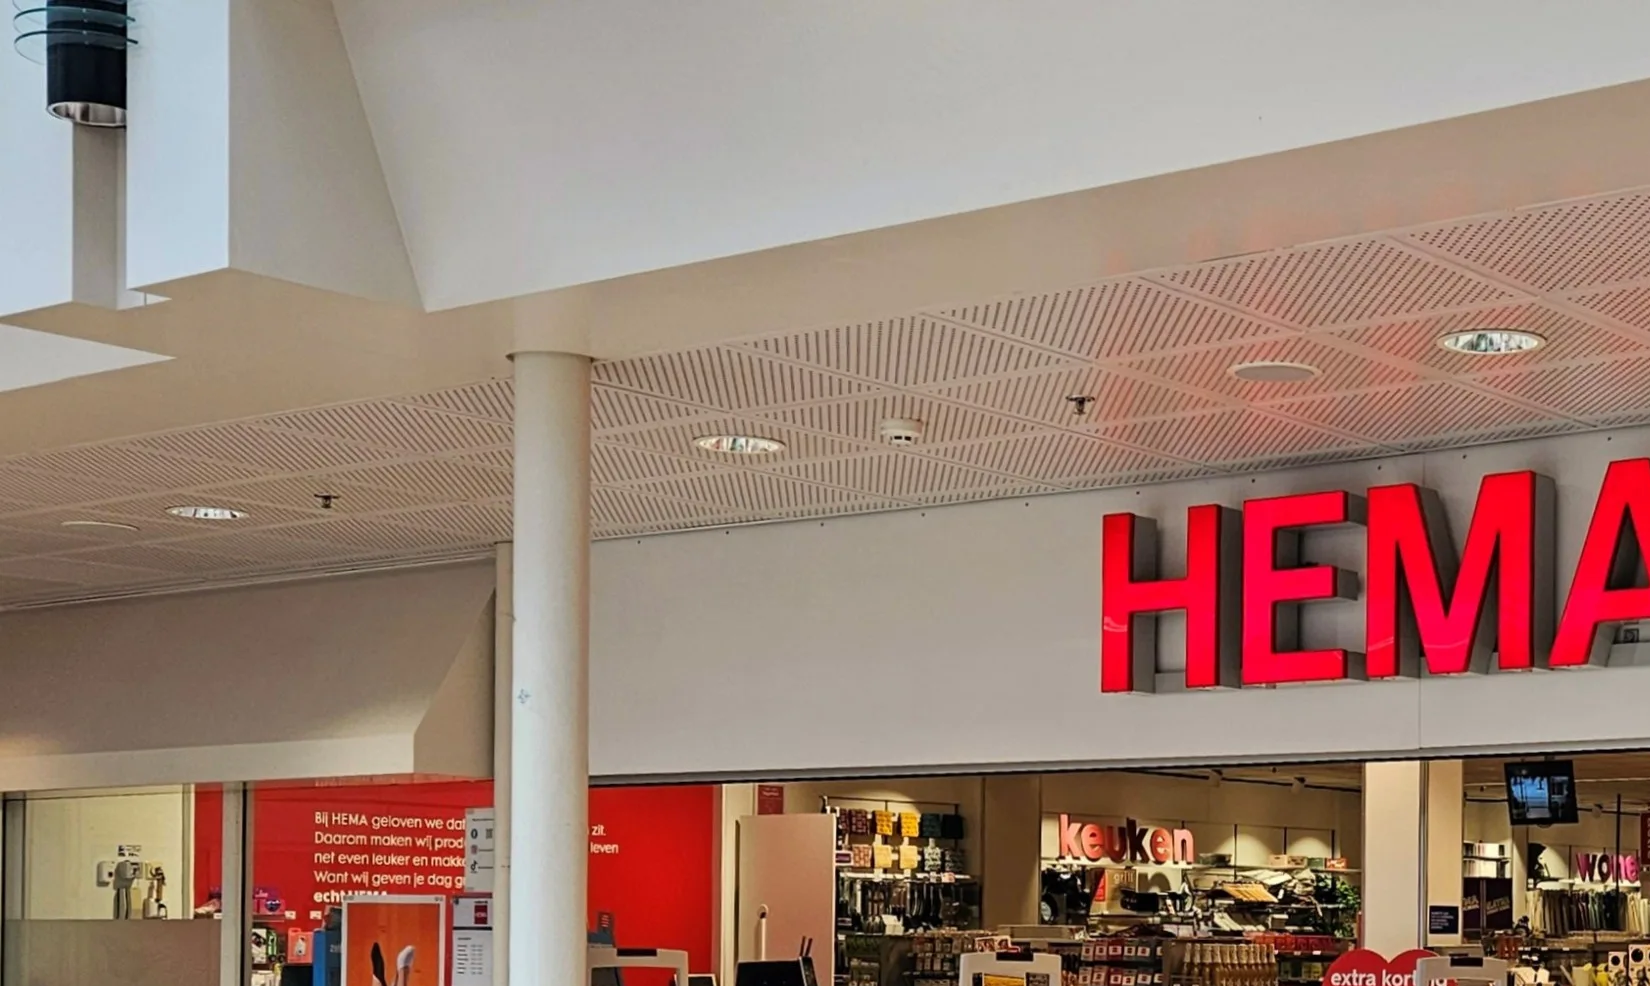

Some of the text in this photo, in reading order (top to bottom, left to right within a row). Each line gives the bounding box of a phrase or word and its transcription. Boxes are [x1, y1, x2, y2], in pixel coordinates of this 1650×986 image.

[314, 810, 329, 827] Bij
[331, 812, 368, 827] HEMA
[371, 815, 422, 830] geloven
[424, 818, 444, 830] we
[446, 816, 466, 831] dat
[591, 824, 607, 837] zit.
[314, 831, 619, 855] Daarom maken wij prod leven
[1058, 812, 1195, 864] keuken
[314, 852, 336, 865] net
[338, 854, 369, 866] even
[371, 853, 410, 867] leuker
[412, 856, 429, 867] en
[1576, 852, 1640, 883] wone
[313, 870, 349, 884] Want
[351, 871, 369, 887] wij
[371, 873, 411, 888] geven
[412, 872, 425, 889] je
[427, 873, 452, 889] dag
[1113, 872, 1135, 885] grill
[313, 889, 343, 904] echt
[1330, 969, 1377, 986] extra
